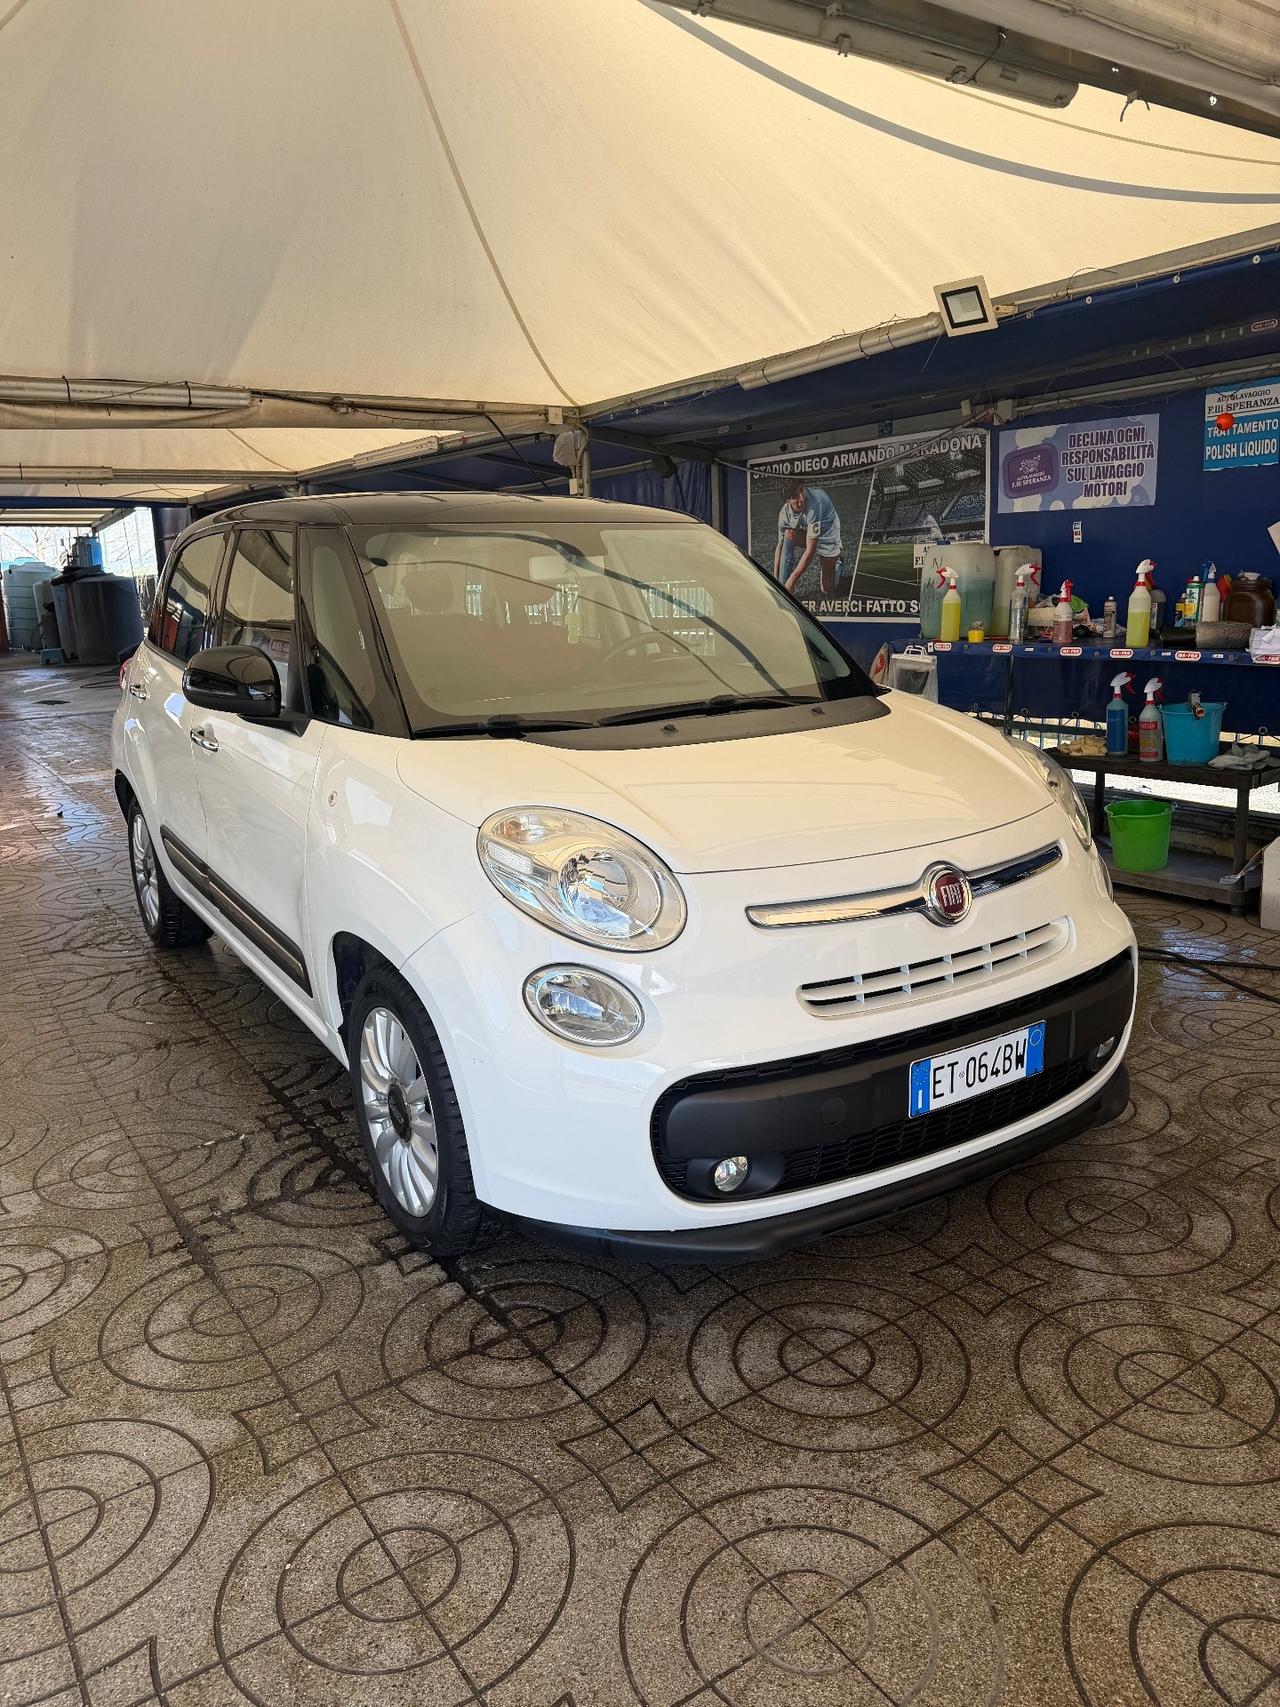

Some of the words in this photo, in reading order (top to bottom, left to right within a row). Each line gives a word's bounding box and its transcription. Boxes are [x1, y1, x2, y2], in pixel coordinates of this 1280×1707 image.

[1226, 396, 1280, 412] SPERANZA
[1069, 429, 1114, 448] DECLINA
[1117, 427, 1146, 443] OGNI
[1061, 441, 1155, 465] RESPONSABILITÀ
[1205, 443, 1237, 460] POLISH
[1240, 438, 1277, 457] LIQUIDO
[753, 462, 791, 479] STADIO
[794, 456, 829, 474] DIEGO
[832, 446, 895, 469] ARMANDO
[1067, 467, 1086, 482] SUL
[1089, 462, 1145, 480] LAVAGGIO
[1083, 481, 1128, 497] MOTORI
[820, 600, 862, 613] AVERCI
[866, 600, 906, 613] FATTO
[909, 600, 920, 613] S
[940, 882, 962, 907] FIAT
[932, 1061, 959, 1100] ET
[965, 1038, 1027, 1088] 064BW
